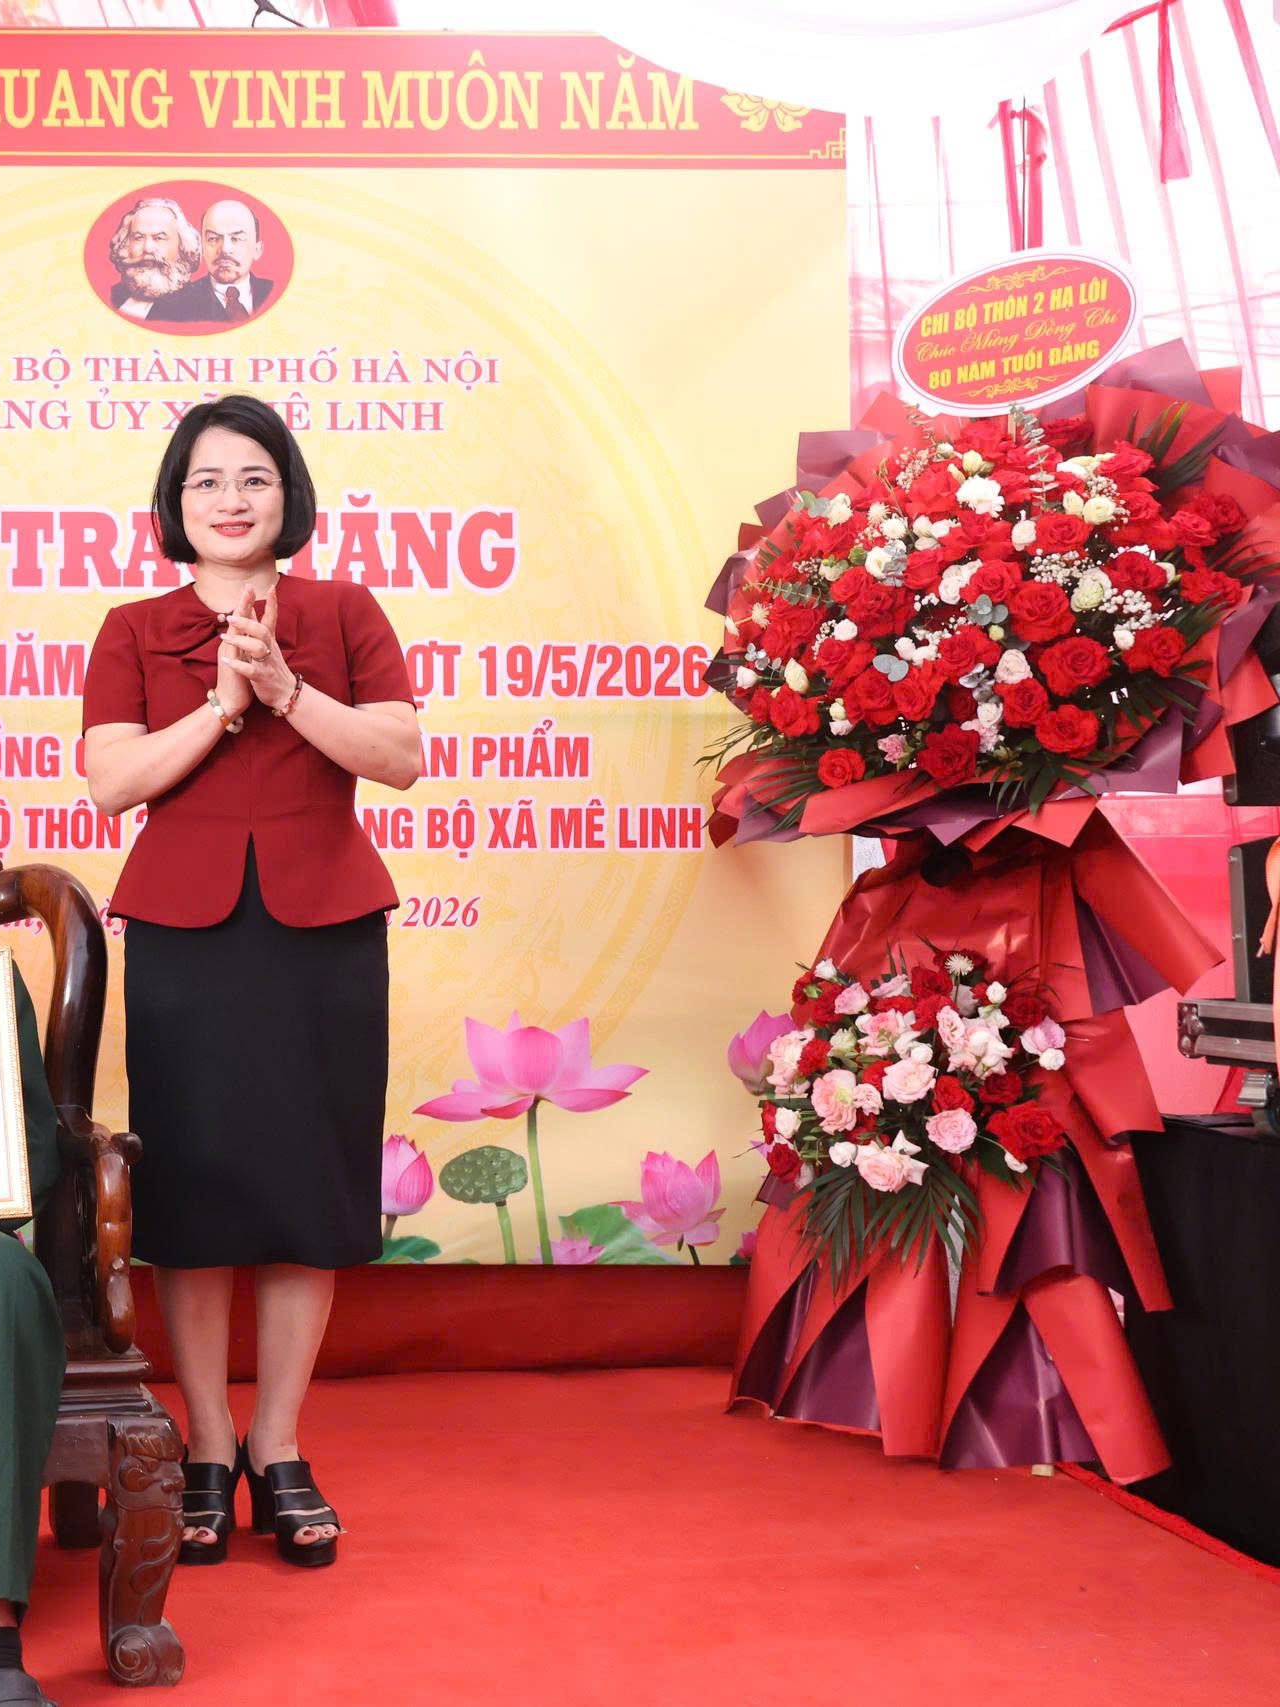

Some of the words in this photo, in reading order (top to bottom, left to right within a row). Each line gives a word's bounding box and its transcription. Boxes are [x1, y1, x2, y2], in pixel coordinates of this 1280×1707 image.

[192, 69, 346, 129] VINH
[363, 50, 545, 130] MUÔN
[561, 50, 699, 131] NĂM
[920, 312, 950, 338] CHI
[954, 302, 978, 332] BỘ
[982, 294, 1029, 325] THÔN
[1032, 291, 1045, 315] 2
[1049, 285, 1074, 313] HẠ
[1079, 277, 1108, 305] LÔI
[13, 348, 72, 390] BỘ
[83, 349, 235, 383] THÀNH
[248, 346, 339, 384] PHỐ
[351, 350, 412, 384] HÀ
[423, 349, 500, 392] NỘI
[928, 368, 953, 390] 80
[957, 357, 996, 384] NĂM
[1001, 347, 1044, 376] TUỔI
[1048, 338, 1101, 367] ĐẢNG
[86, 387, 151, 430] ỦY
[266, 392, 312, 431] Ê
[325, 402, 444, 431] LINH
[0, 510, 196, 588] TRA
[406, 640, 462, 710] ỢT
[478, 645, 710, 697] 19/5/2026
[472, 718, 589, 778] PHẨM
[23, 799, 122, 850] THÔN
[363, 808, 414, 849] NG
[427, 800, 476, 859] BỘ
[488, 802, 540, 850] XÃ
[550, 800, 607, 850] MÊ
[619, 808, 702, 850] LINH
[401, 896, 481, 928] 2026
